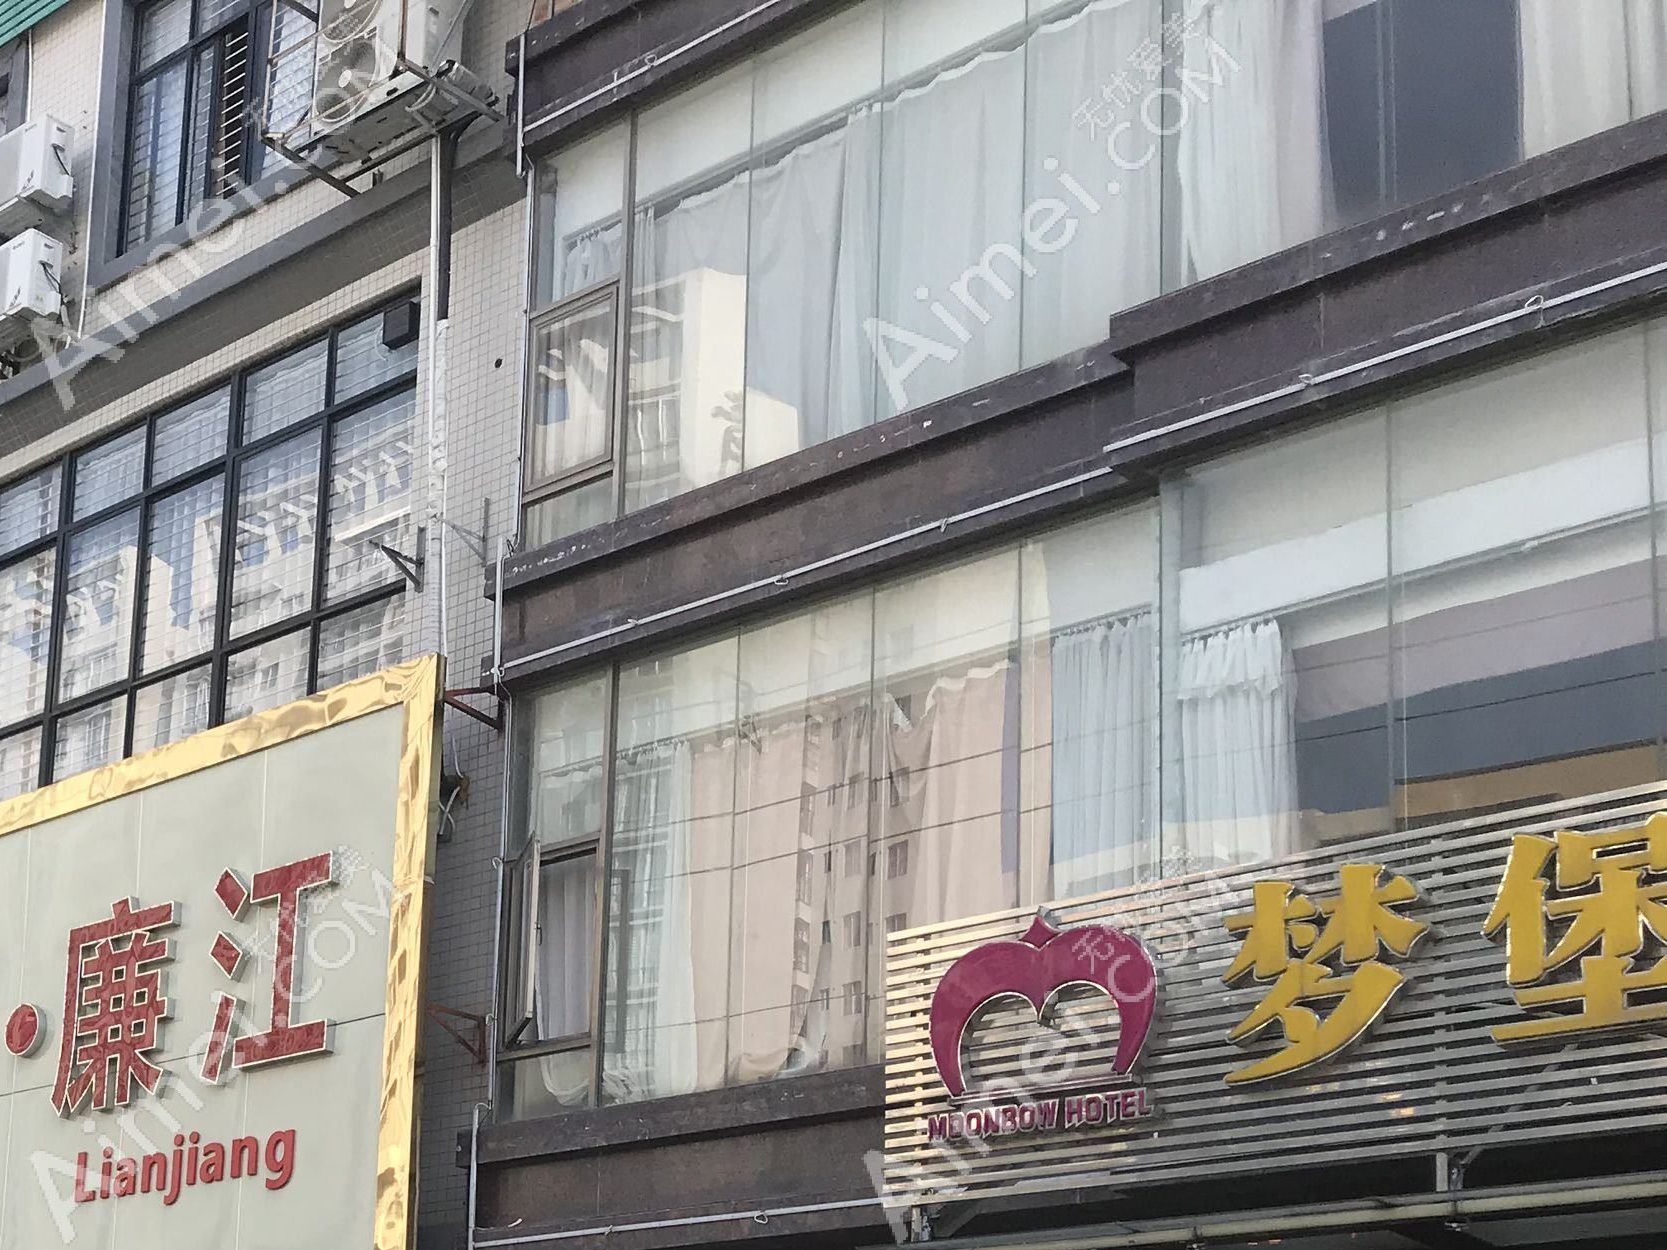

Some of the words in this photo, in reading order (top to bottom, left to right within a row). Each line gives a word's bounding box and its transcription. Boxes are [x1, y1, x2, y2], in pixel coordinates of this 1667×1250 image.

[1222, 811, 1667, 1086] 梦堡
[928, 1098, 1058, 1142] MOONBOW
[1064, 1088, 1152, 1129] HOTEL
[74, 1128, 297, 1206] Lianjiang
